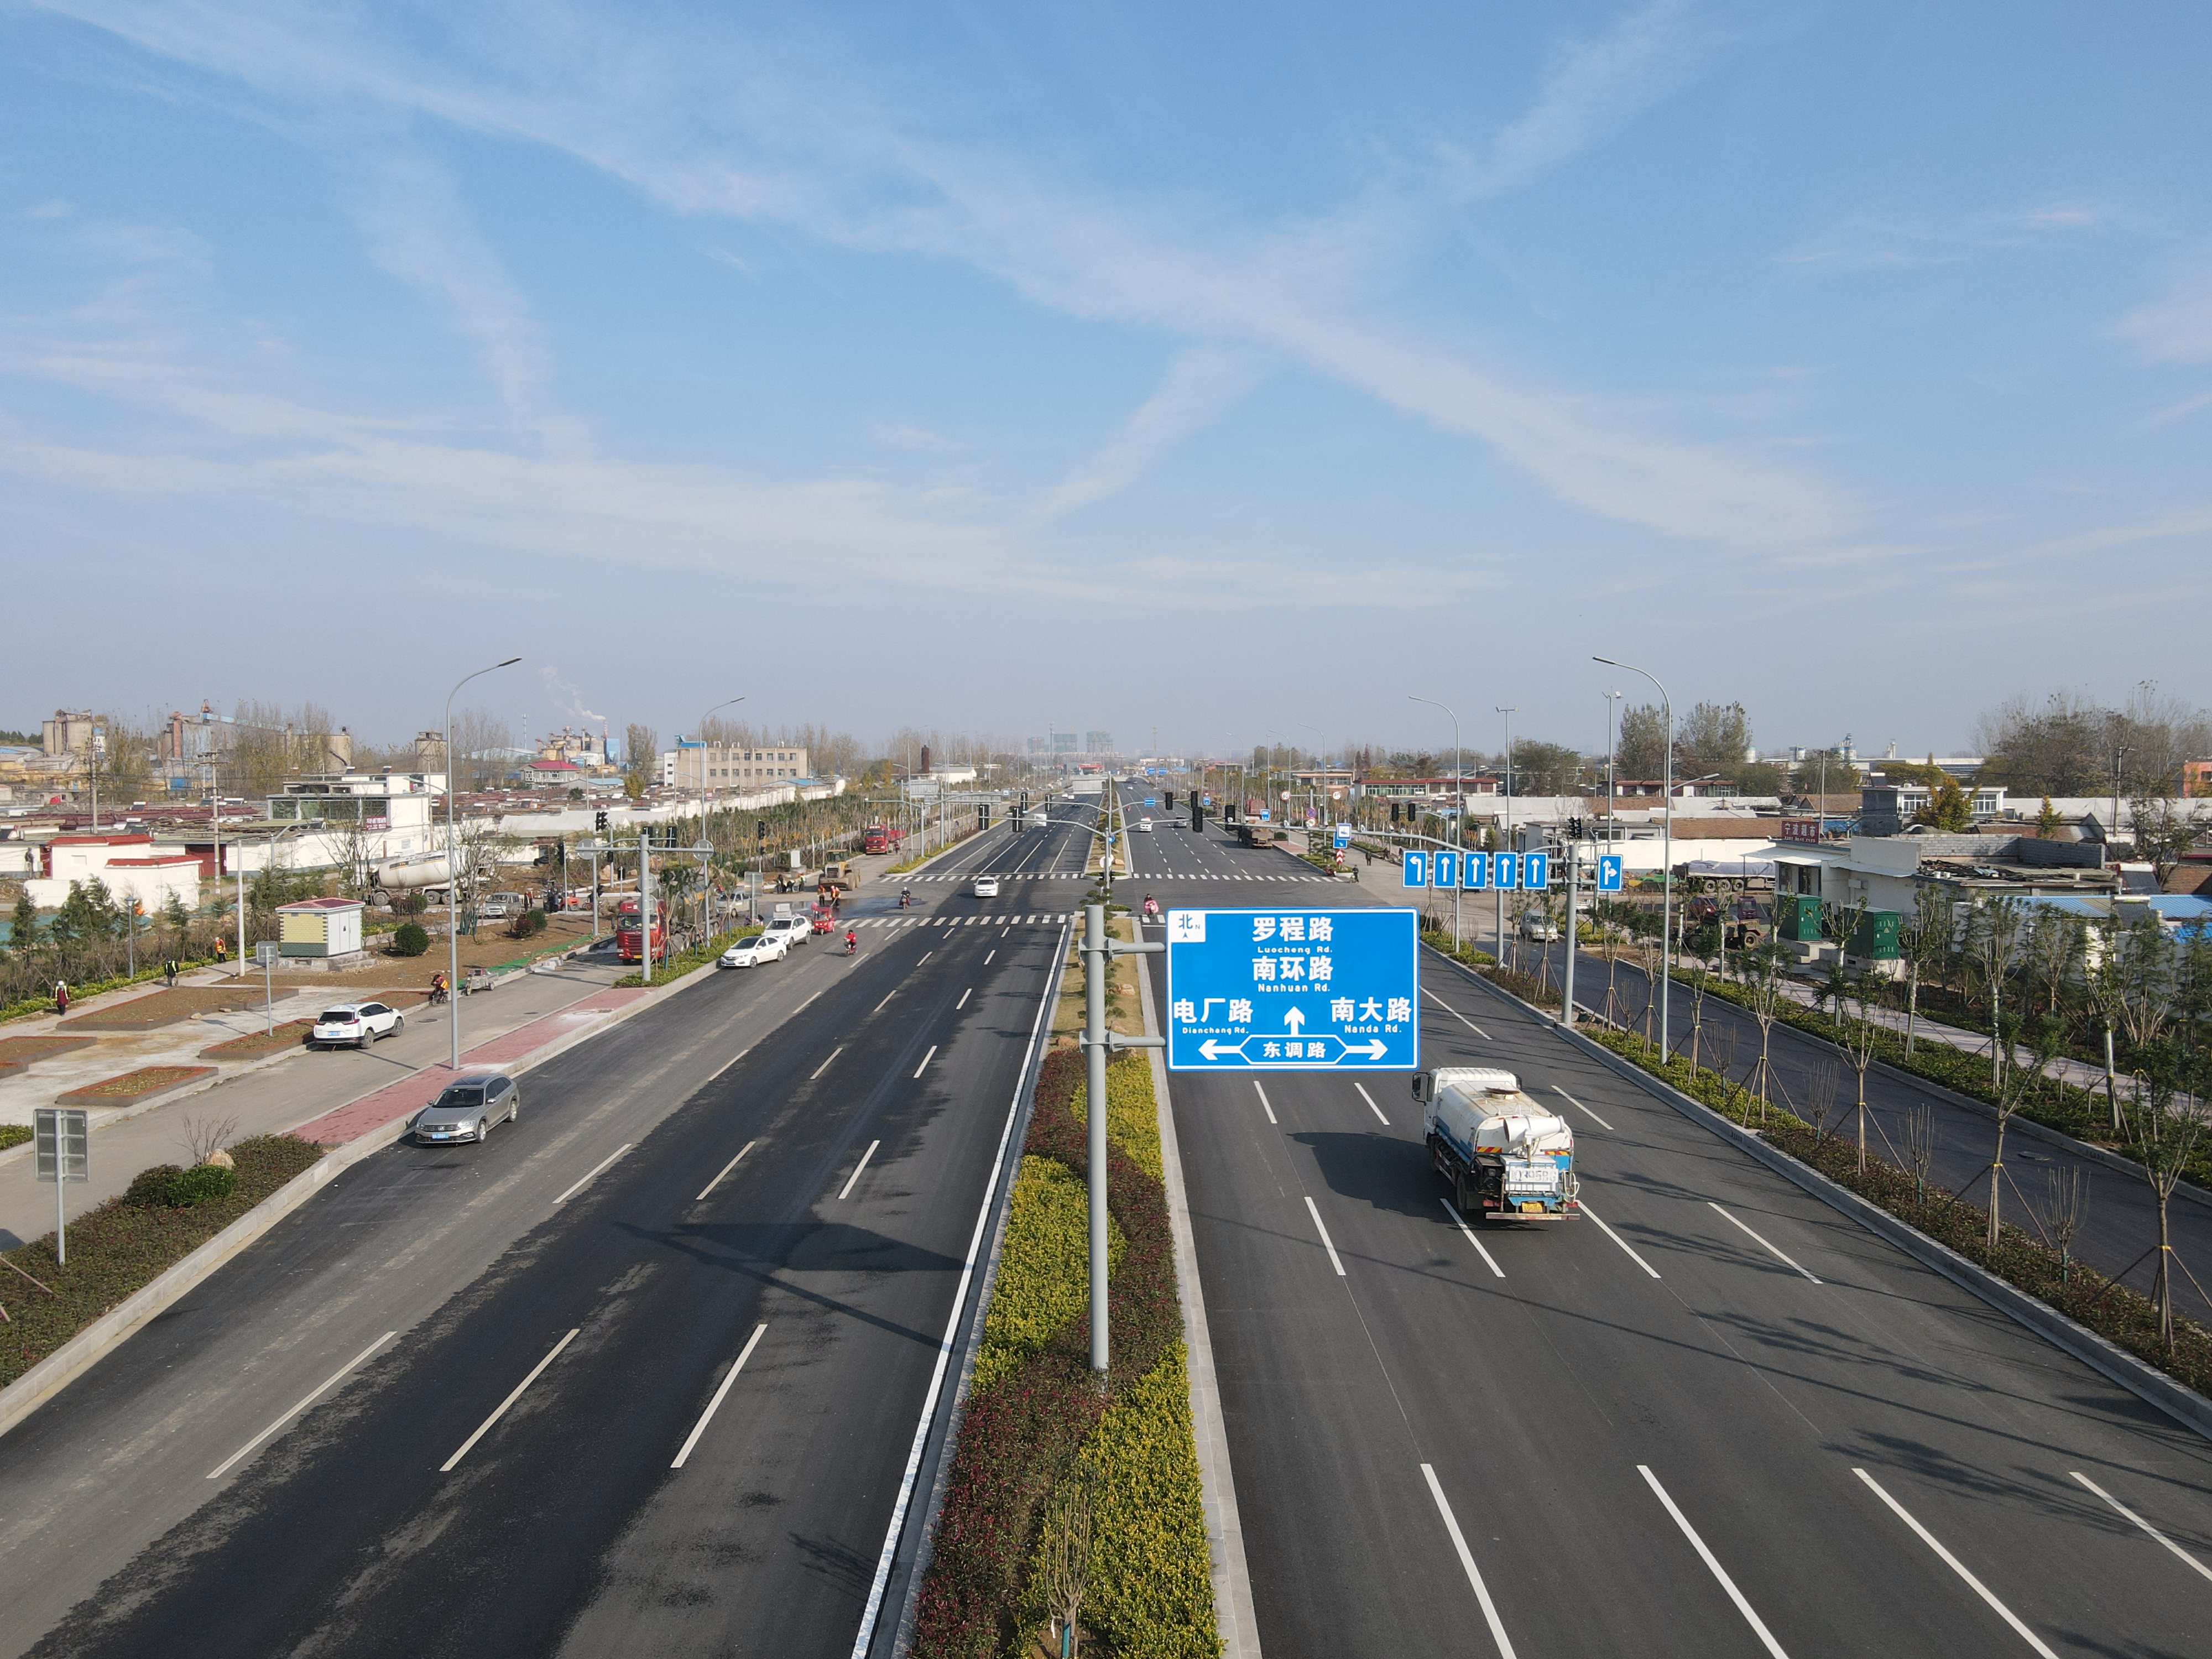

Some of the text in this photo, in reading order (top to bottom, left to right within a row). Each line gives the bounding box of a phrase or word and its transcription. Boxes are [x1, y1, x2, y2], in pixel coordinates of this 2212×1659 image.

[1178, 914, 1193, 930] 北
[1252, 916, 1334, 942] 罗程路
[1258, 946, 1311, 955] Luocheng
[1251, 955, 1334, 982] 南环路
[1258, 983, 1330, 993] Nanhuan Rd.
[1173, 998, 1254, 1024] 电厂路
[1330, 997, 1412, 1022] 南大路
[1182, 1027, 1232, 1035] Dianchang
[1344, 1024, 1402, 1034] Nanda Rd.
[1262, 1041, 1326, 1058] 东调路
